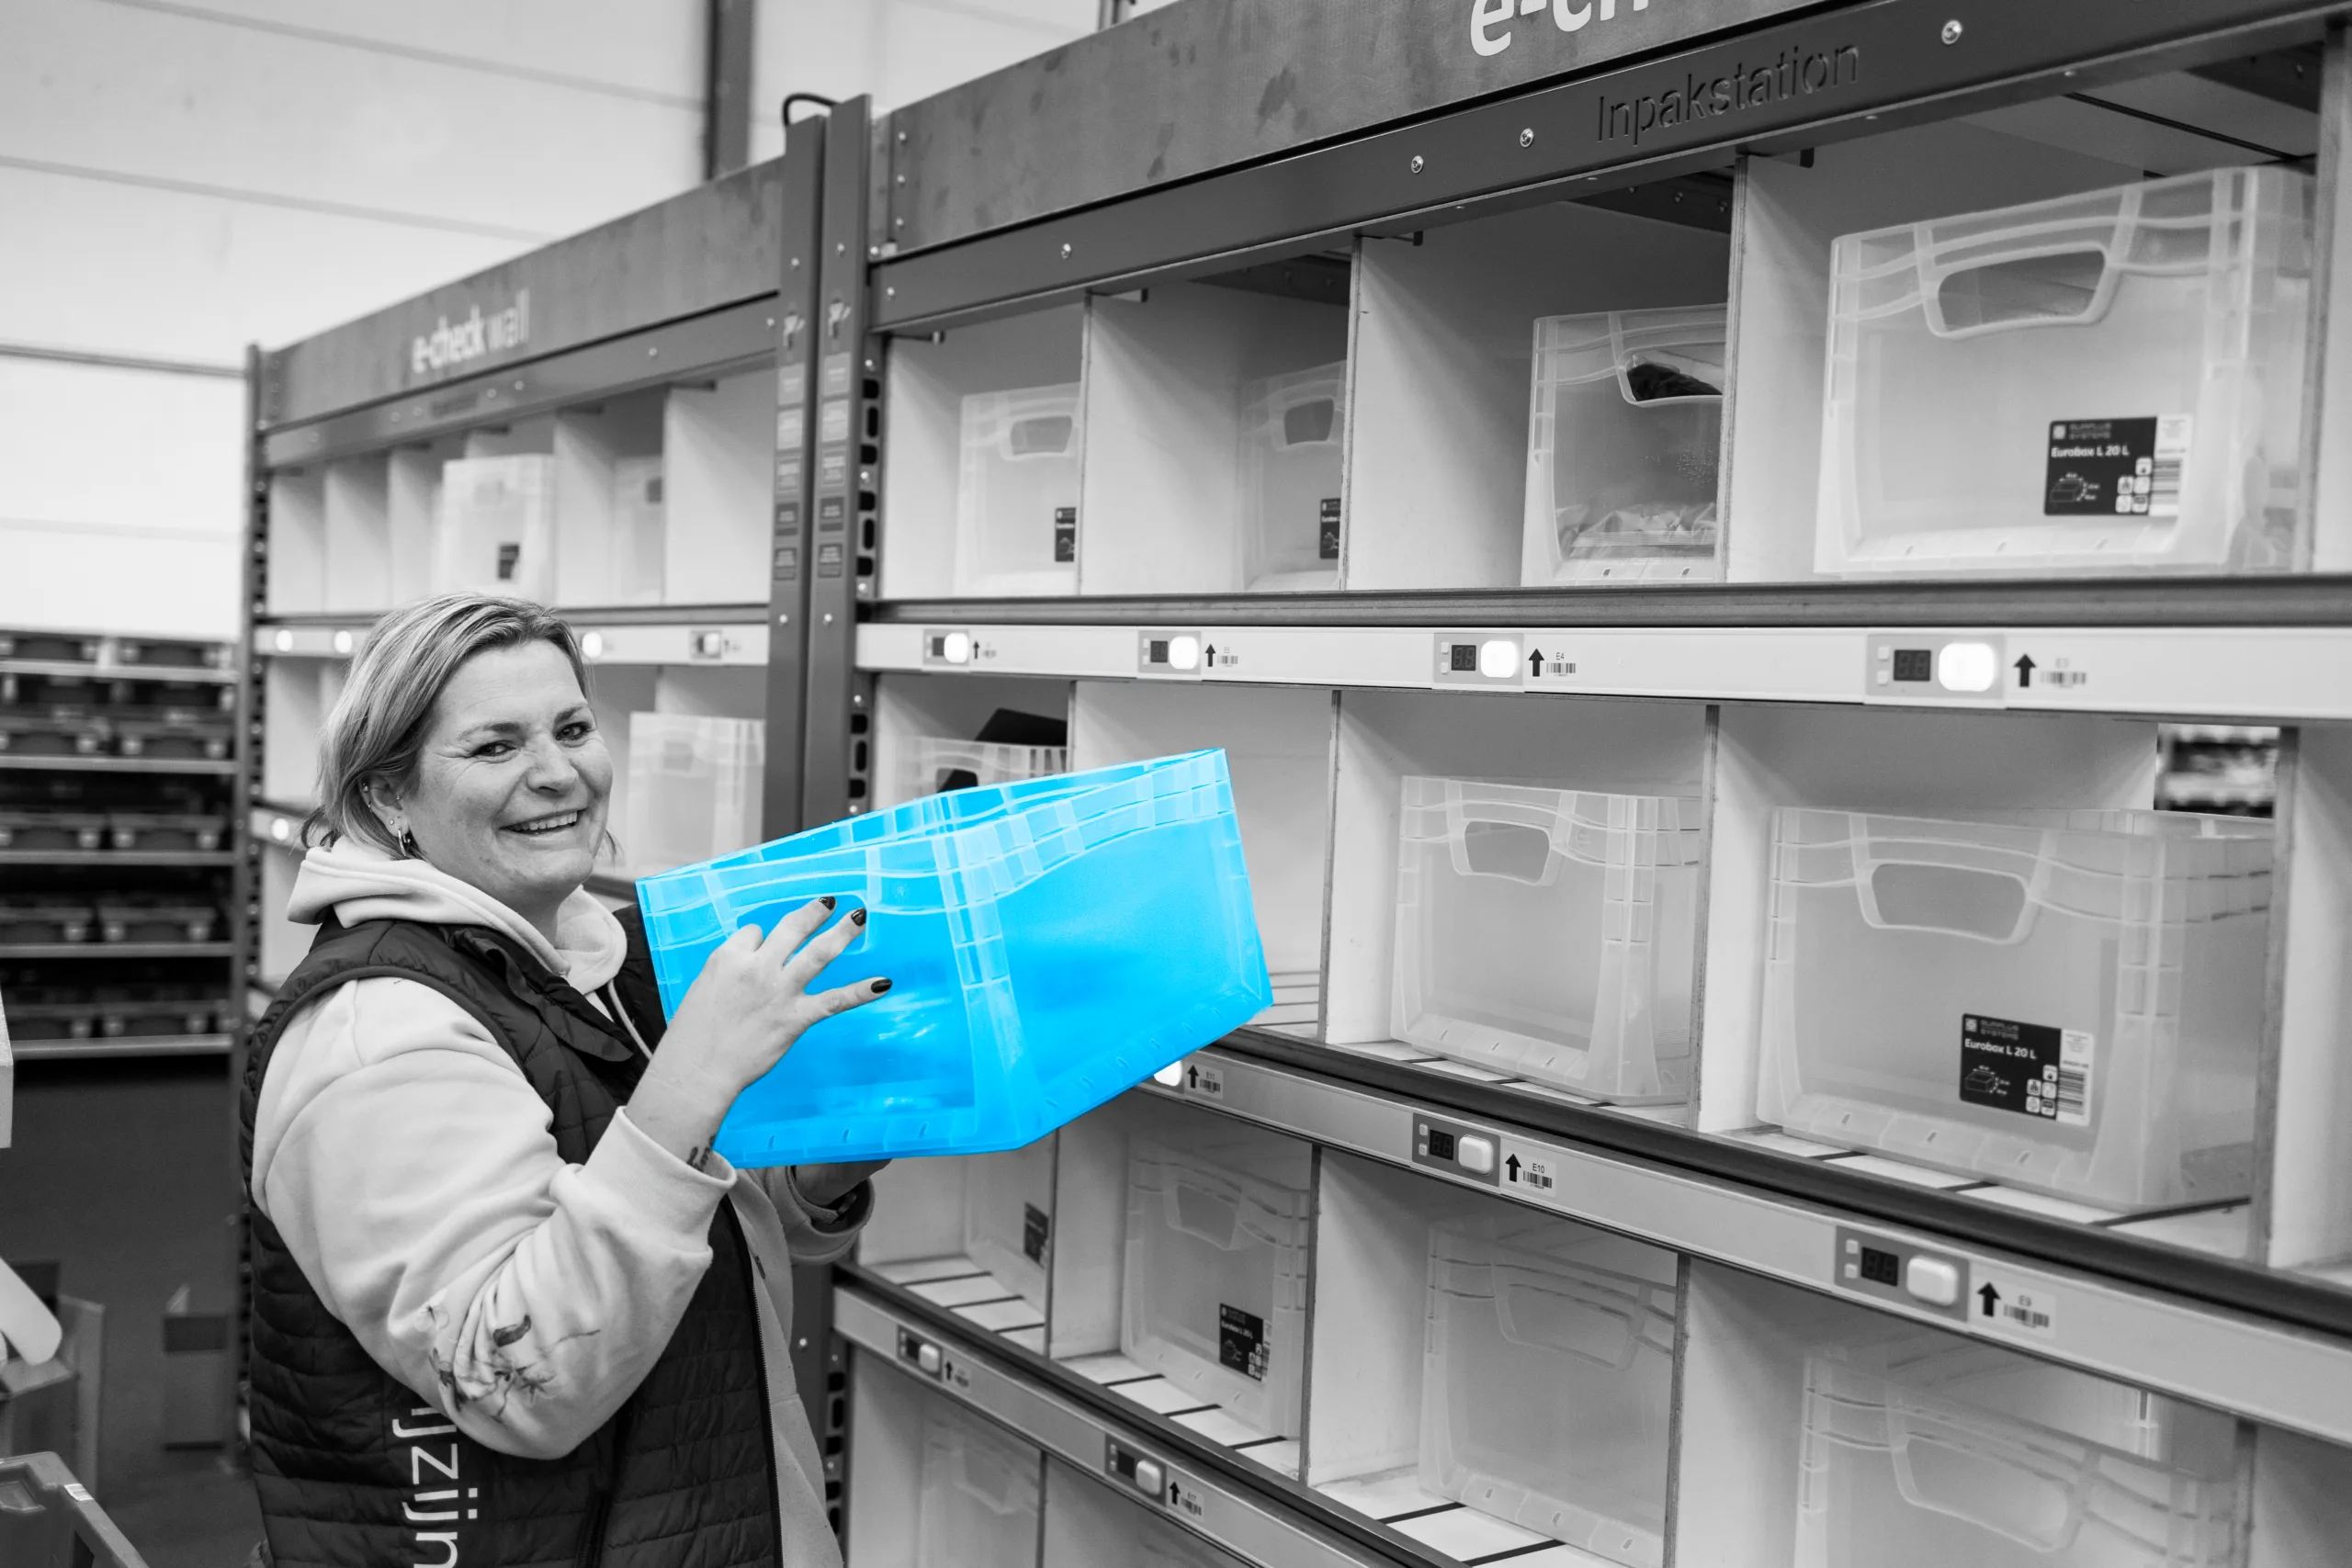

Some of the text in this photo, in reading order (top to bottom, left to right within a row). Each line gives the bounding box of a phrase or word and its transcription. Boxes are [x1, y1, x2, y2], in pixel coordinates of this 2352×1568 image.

[1597, 44, 1860, 146] Inpakstation
[2051, 446, 2095, 457] Eurobox
[1555, 651, 1565, 660] E4
[1964, 1038, 2037, 1060] Eurobox L 20 L
[1532, 1163, 1545, 1174] E10
